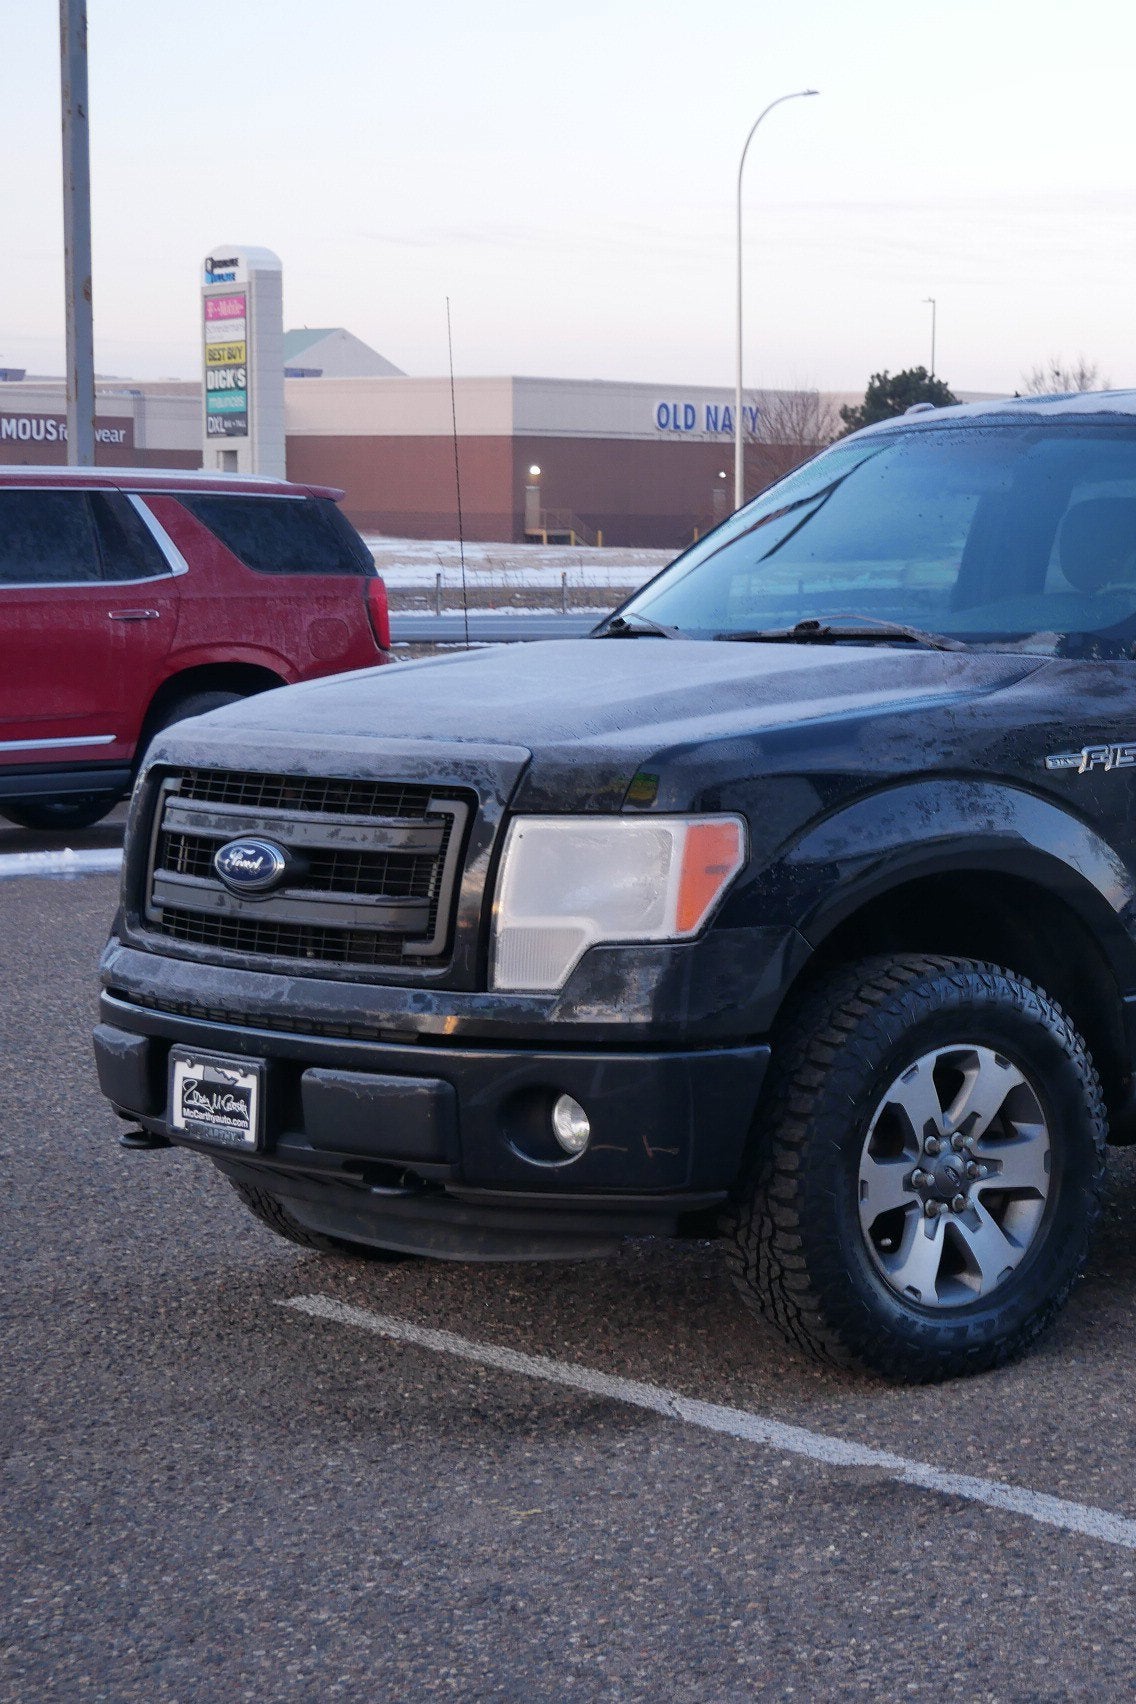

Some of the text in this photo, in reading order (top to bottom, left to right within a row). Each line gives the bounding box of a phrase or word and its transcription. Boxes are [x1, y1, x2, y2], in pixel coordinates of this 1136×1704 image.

[207, 368, 246, 391] DICK'S
[656, 402, 696, 431] OLD
[0, 418, 126, 443] MOUS fwear
[223, 846, 264, 872] Ford
